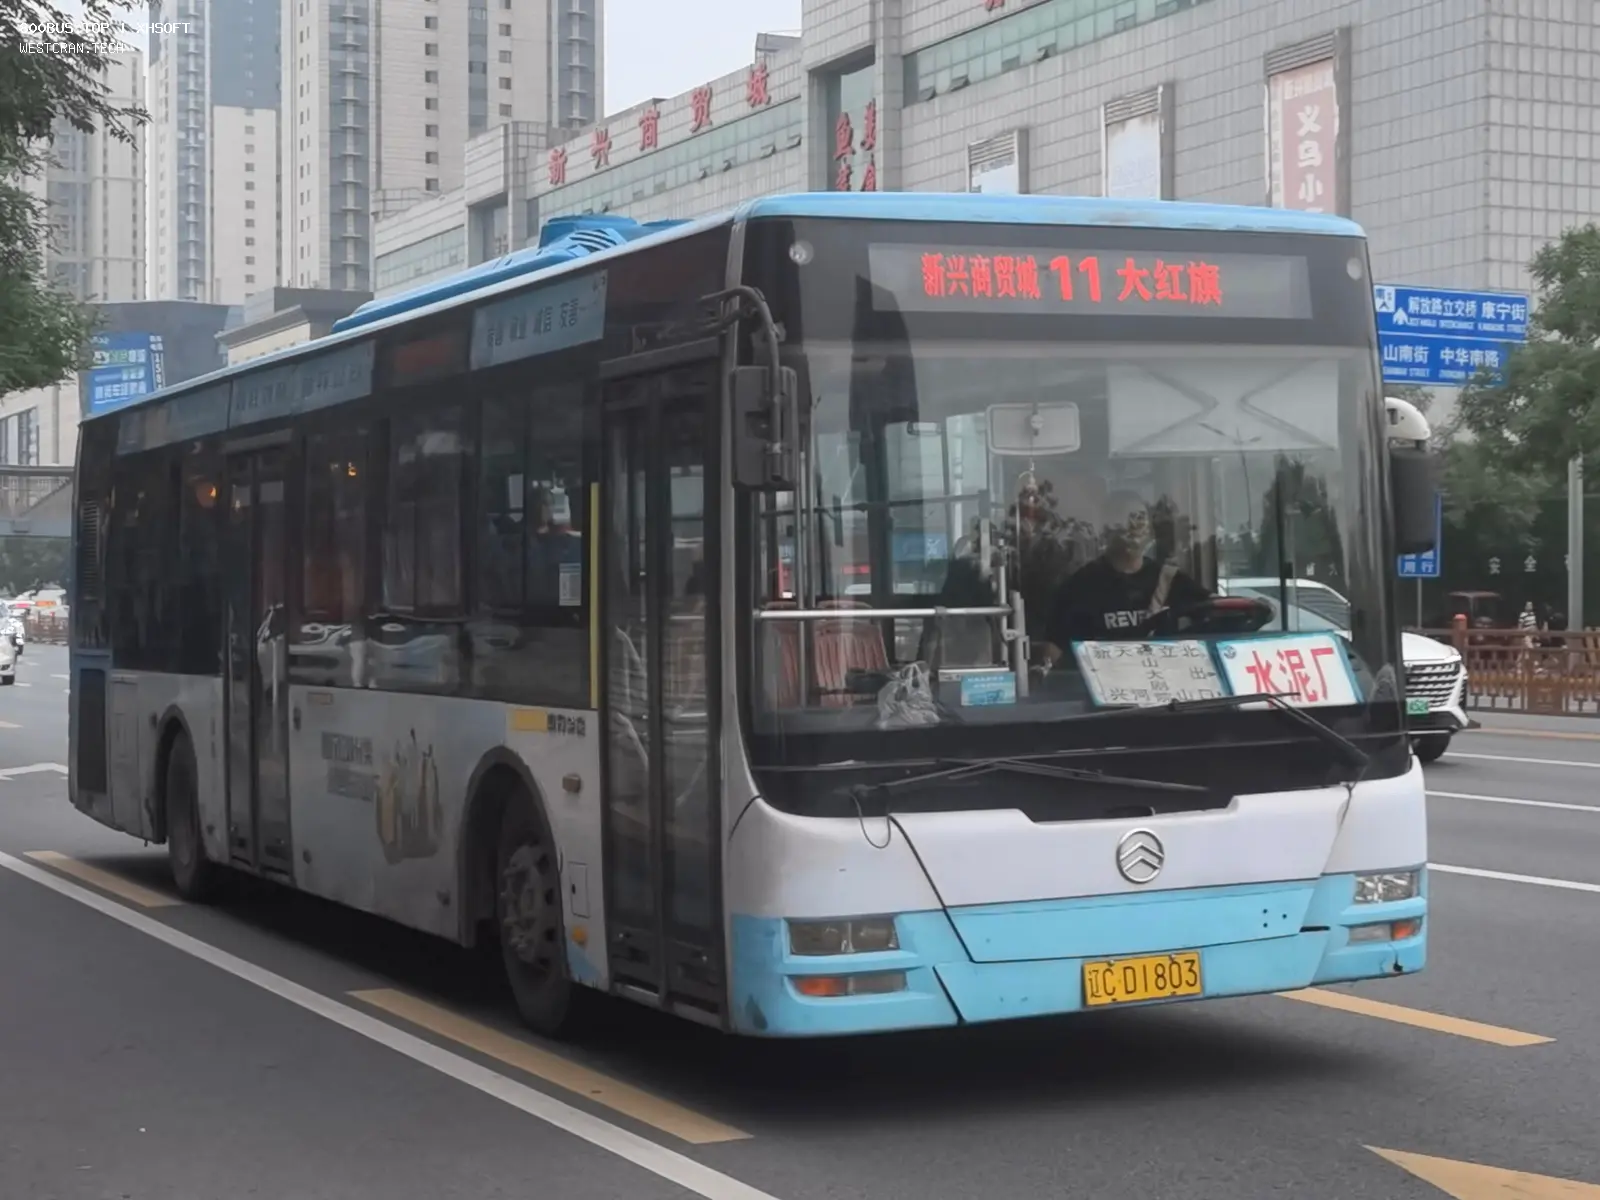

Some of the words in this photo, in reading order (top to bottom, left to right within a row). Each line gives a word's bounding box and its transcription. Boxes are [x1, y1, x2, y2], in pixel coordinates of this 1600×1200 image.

[549, 63, 772, 187] 新兴商贸城
[1296, 104, 1325, 213] 义乌小
[921, 252, 1042, 299] 新兴商贸城
[1050, 256, 1102, 302] 11
[1117, 257, 1223, 305] 大红旗
[1408, 296, 1477, 318] 解放路立交桥
[1482, 301, 1526, 321] 康宁街
[1440, 347, 1500, 368] 中华南路
[1245, 647, 1335, 708] 水泥厂
